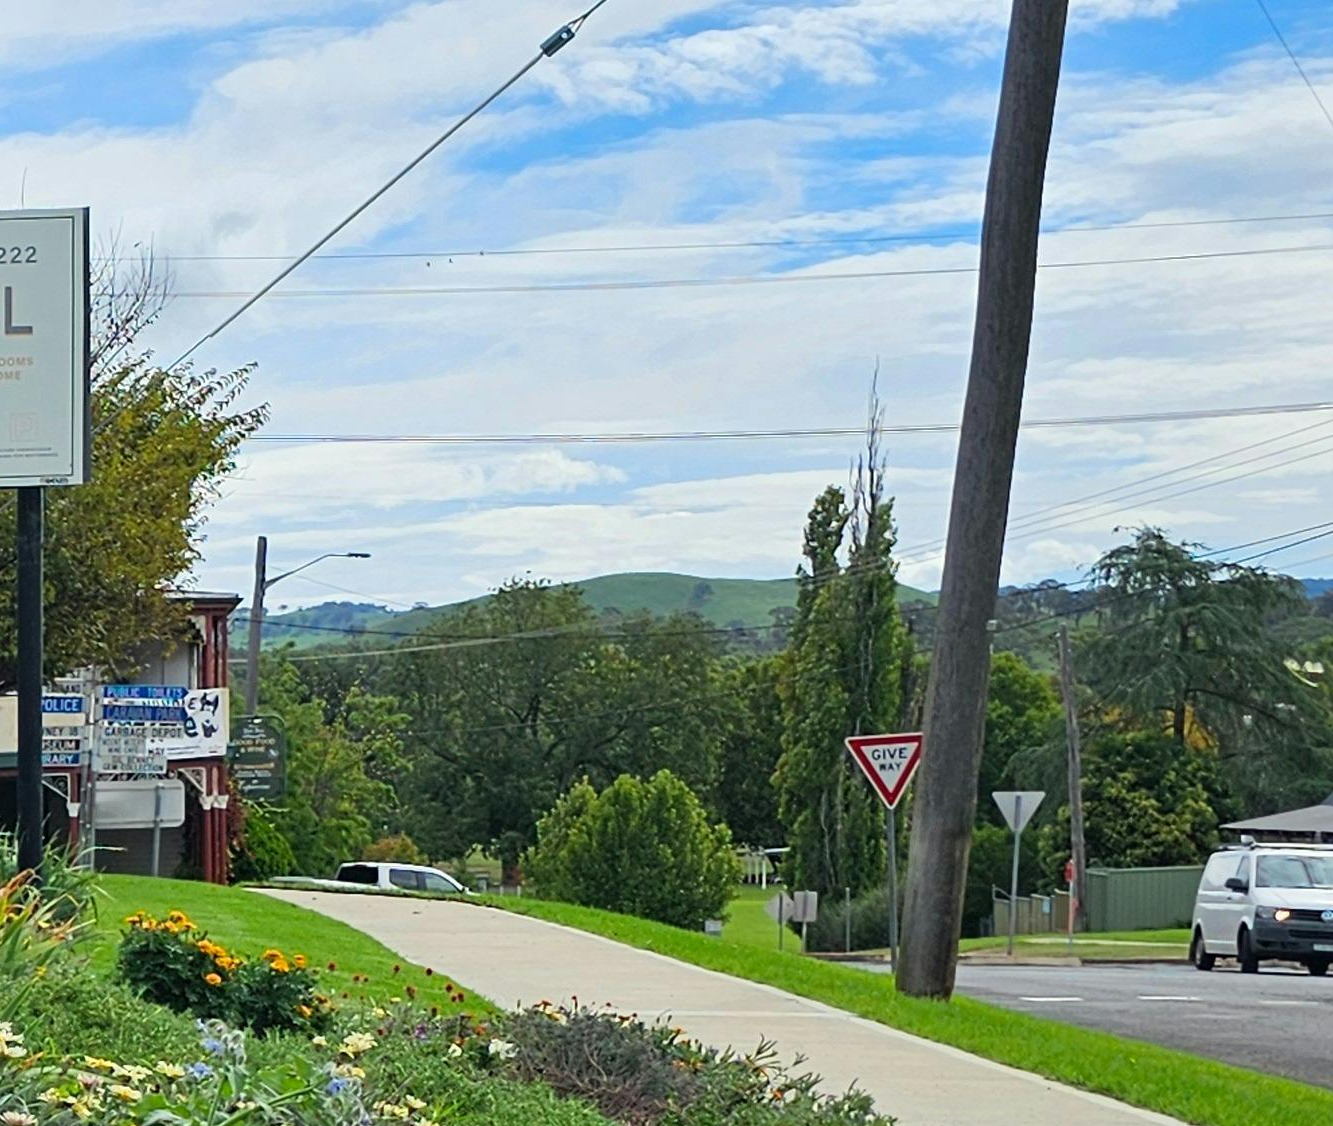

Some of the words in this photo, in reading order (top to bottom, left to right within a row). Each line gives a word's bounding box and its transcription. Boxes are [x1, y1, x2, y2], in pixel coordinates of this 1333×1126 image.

[104, 728, 148, 738] GARBAGE
[151, 727, 184, 737] DEPOT
[871, 747, 908, 760] GIVE
[879, 763, 903, 771] WAY
